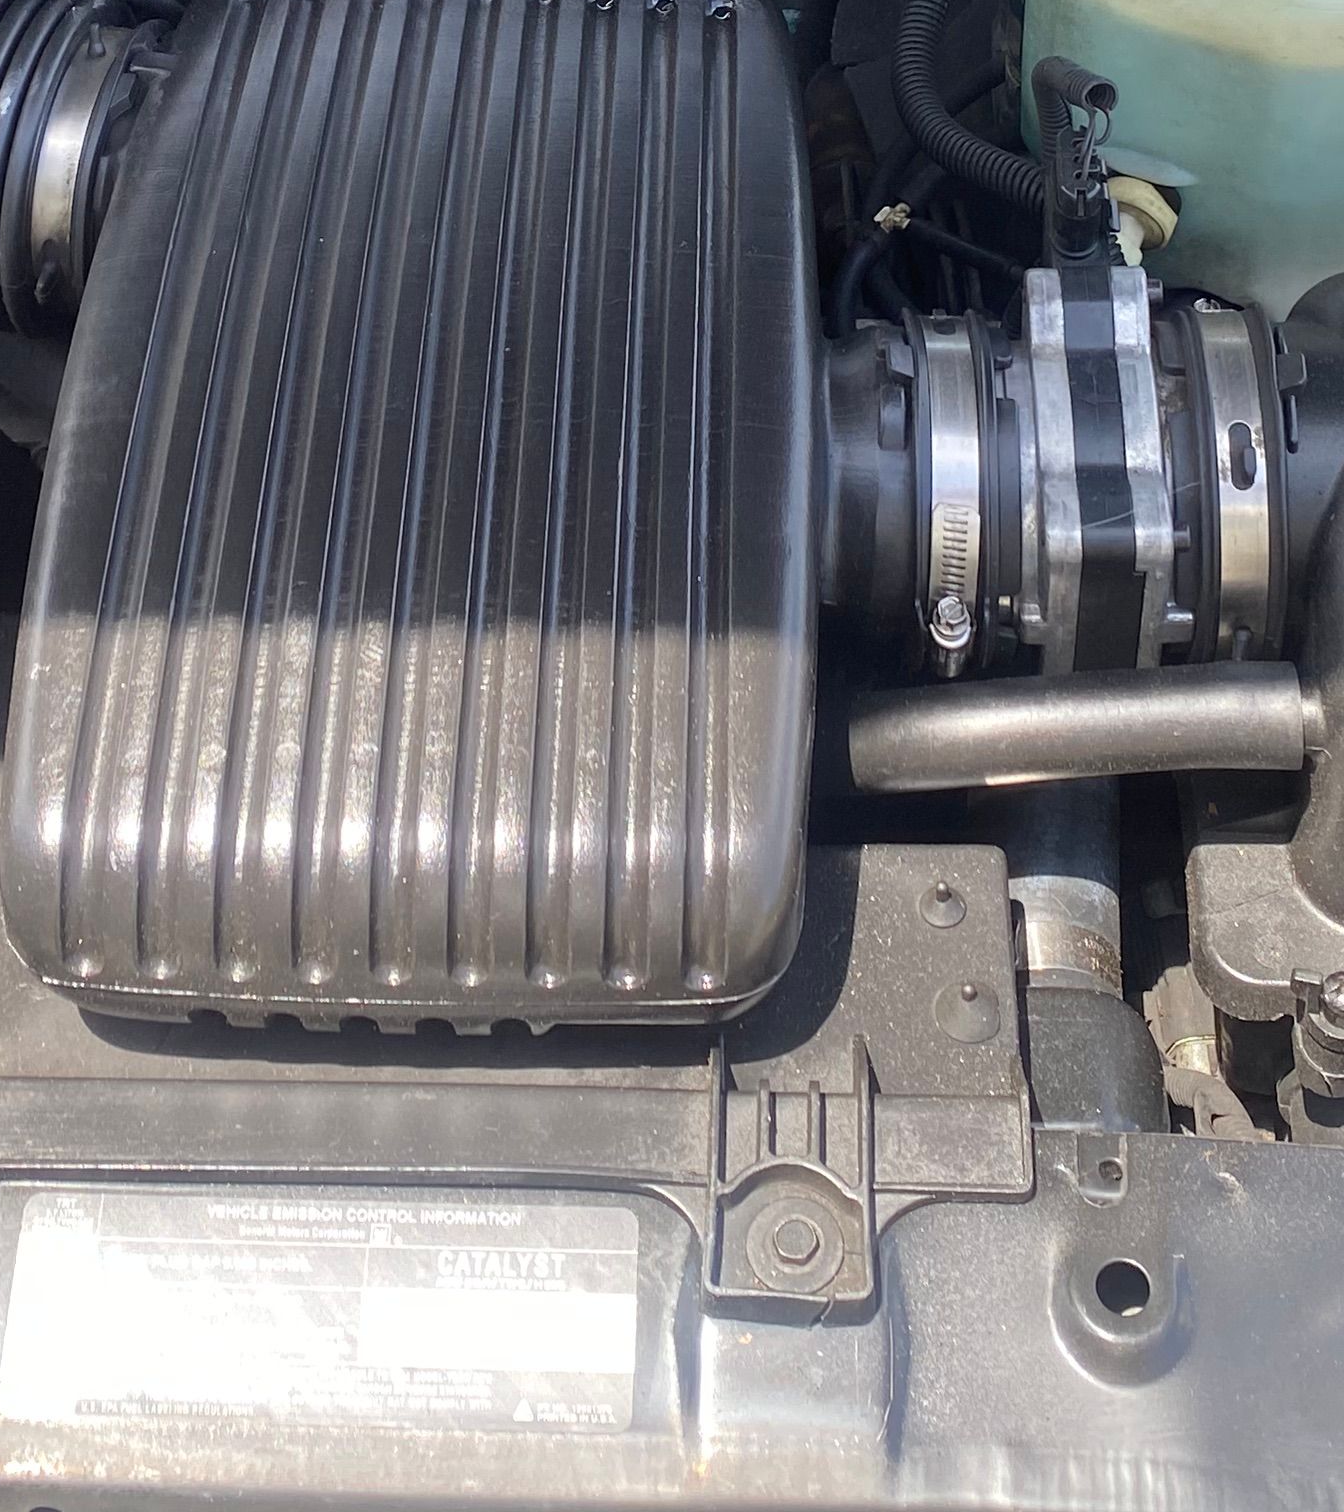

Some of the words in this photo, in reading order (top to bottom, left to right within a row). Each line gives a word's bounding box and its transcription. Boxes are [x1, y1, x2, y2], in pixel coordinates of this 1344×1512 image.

[207, 1204, 268, 1221] VEHICLE
[272, 1206, 343, 1223] EMISSION
[346, 1207, 417, 1224] CONTROL
[420, 1209, 523, 1226] INFORMATION
[437, 1251, 567, 1278] CATALYST
